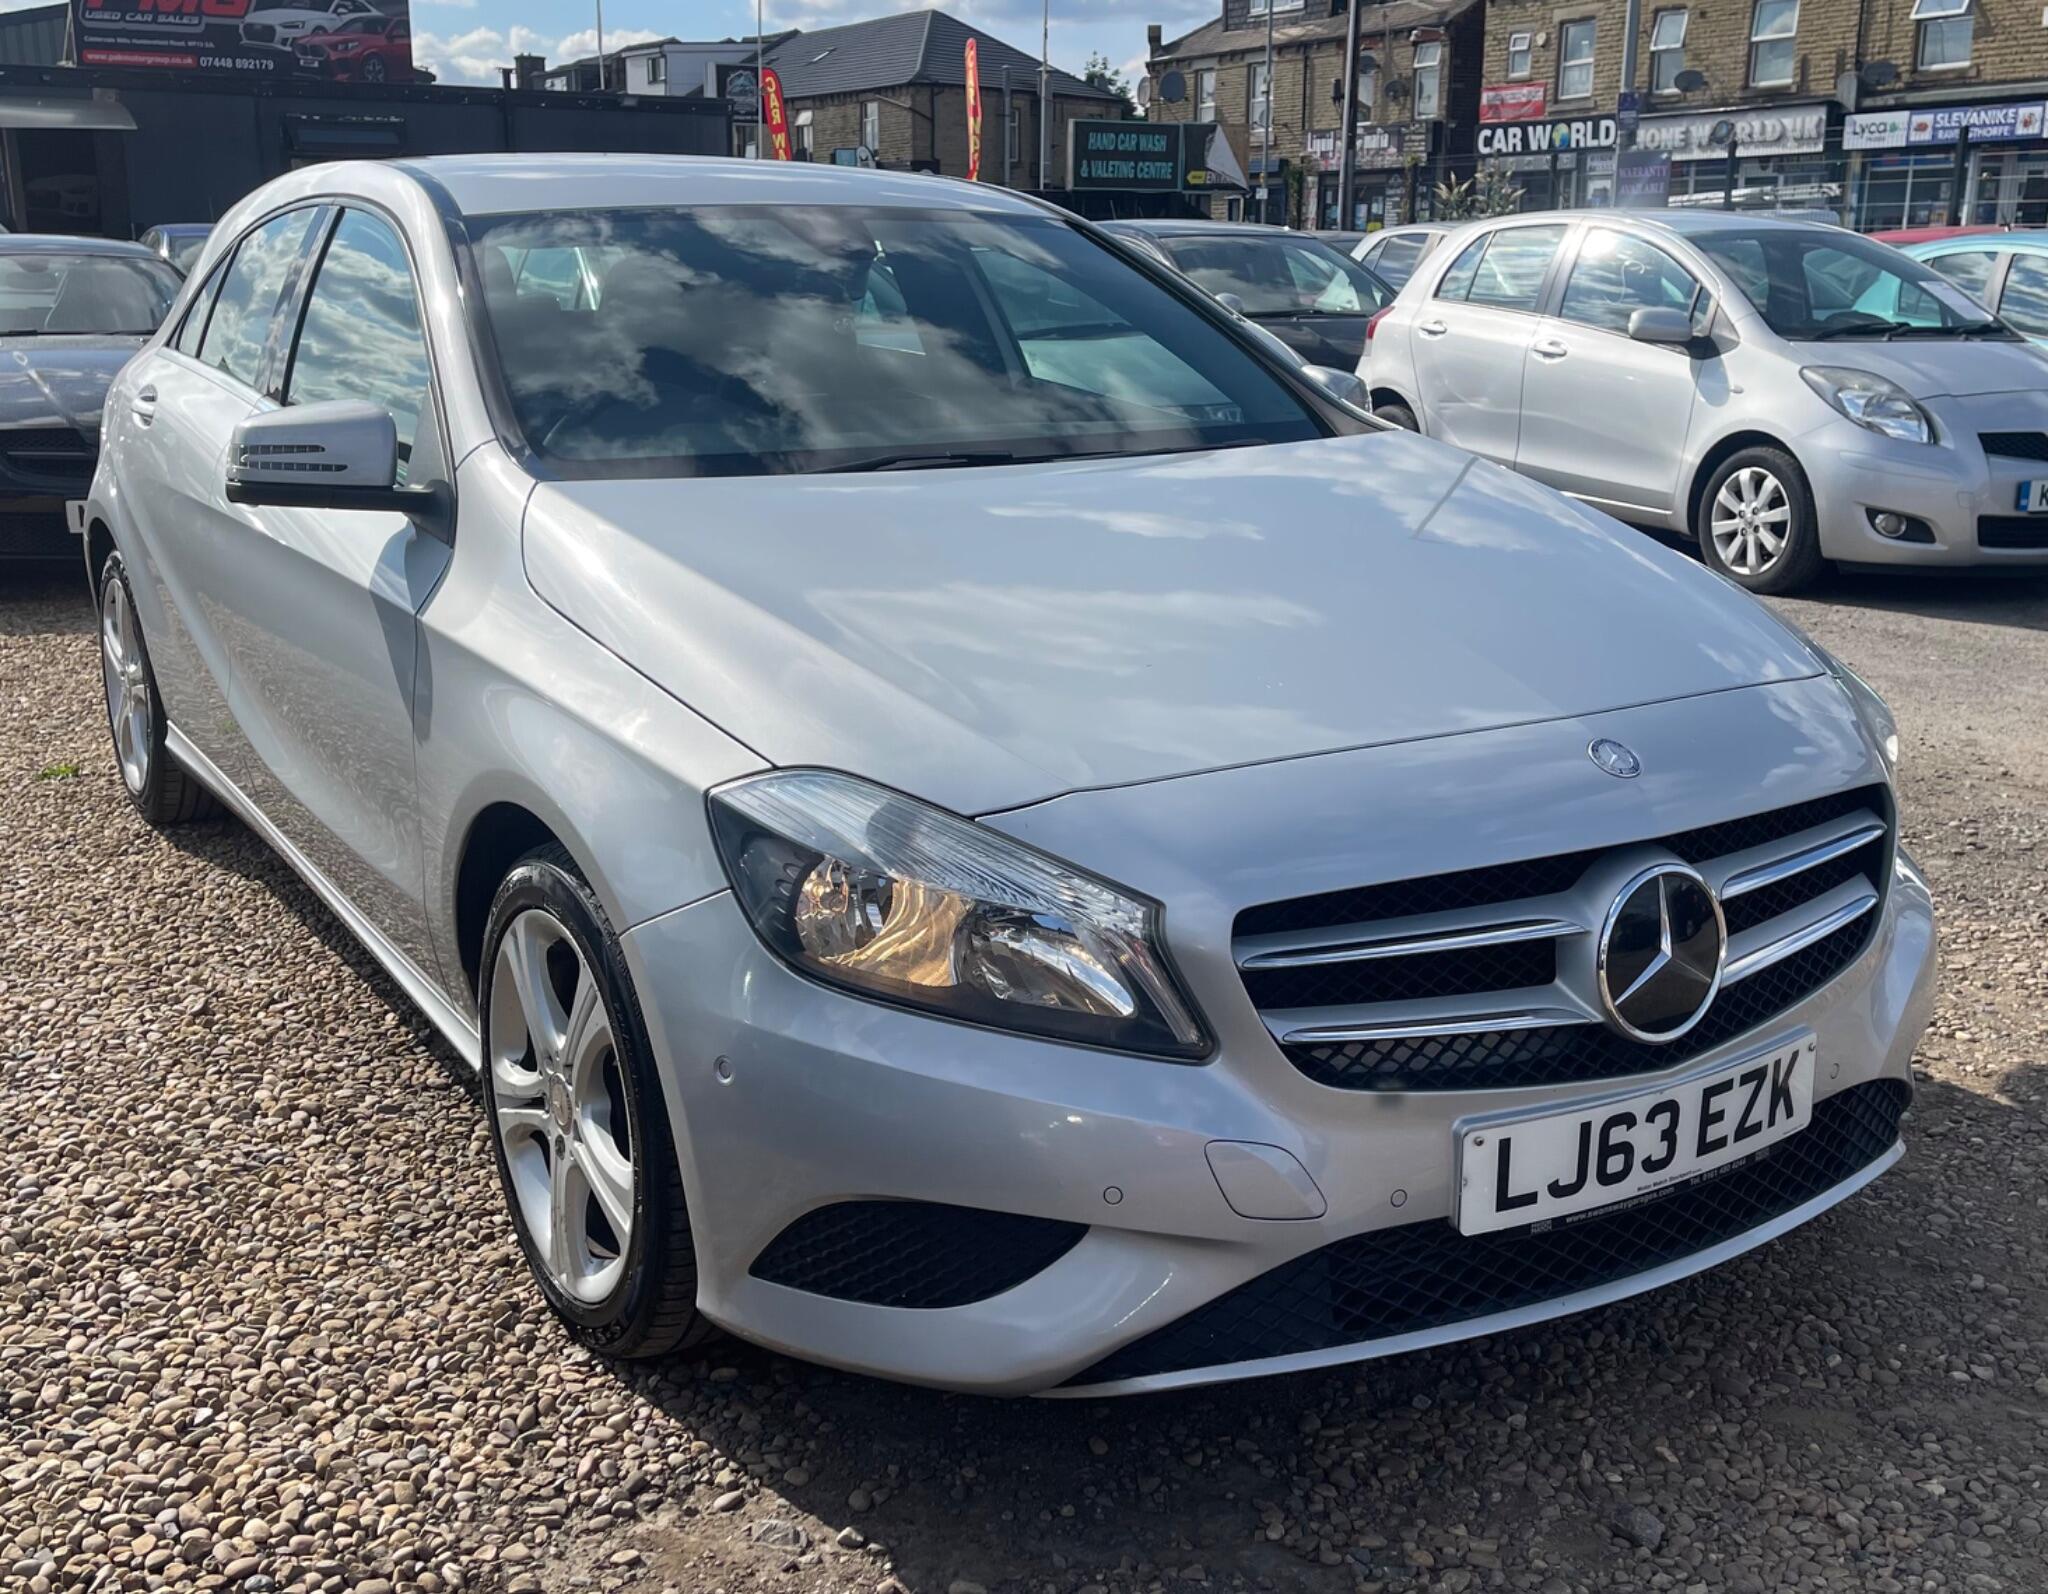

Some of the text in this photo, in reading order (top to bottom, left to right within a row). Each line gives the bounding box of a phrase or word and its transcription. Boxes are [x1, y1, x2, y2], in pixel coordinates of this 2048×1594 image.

[85, 10, 200, 25] USED CAR SALES
[200, 56, 274, 70] 07448 892179
[1935, 109, 2017, 128] SLEVANIKE
[1853, 120, 1888, 136] Lyca
[1088, 132, 1167, 152] HAND CAR WASH
[1478, 127, 1523, 155] CAR
[1080, 160, 1174, 179] & VALETING CENTRE
[1619, 165, 1668, 177] WARRANTY
[1620, 182, 1666, 194] AVAILABLE
[1495, 1049, 1800, 1214] LJ63 EZK
[1702, 1169, 1717, 1182] 0161
